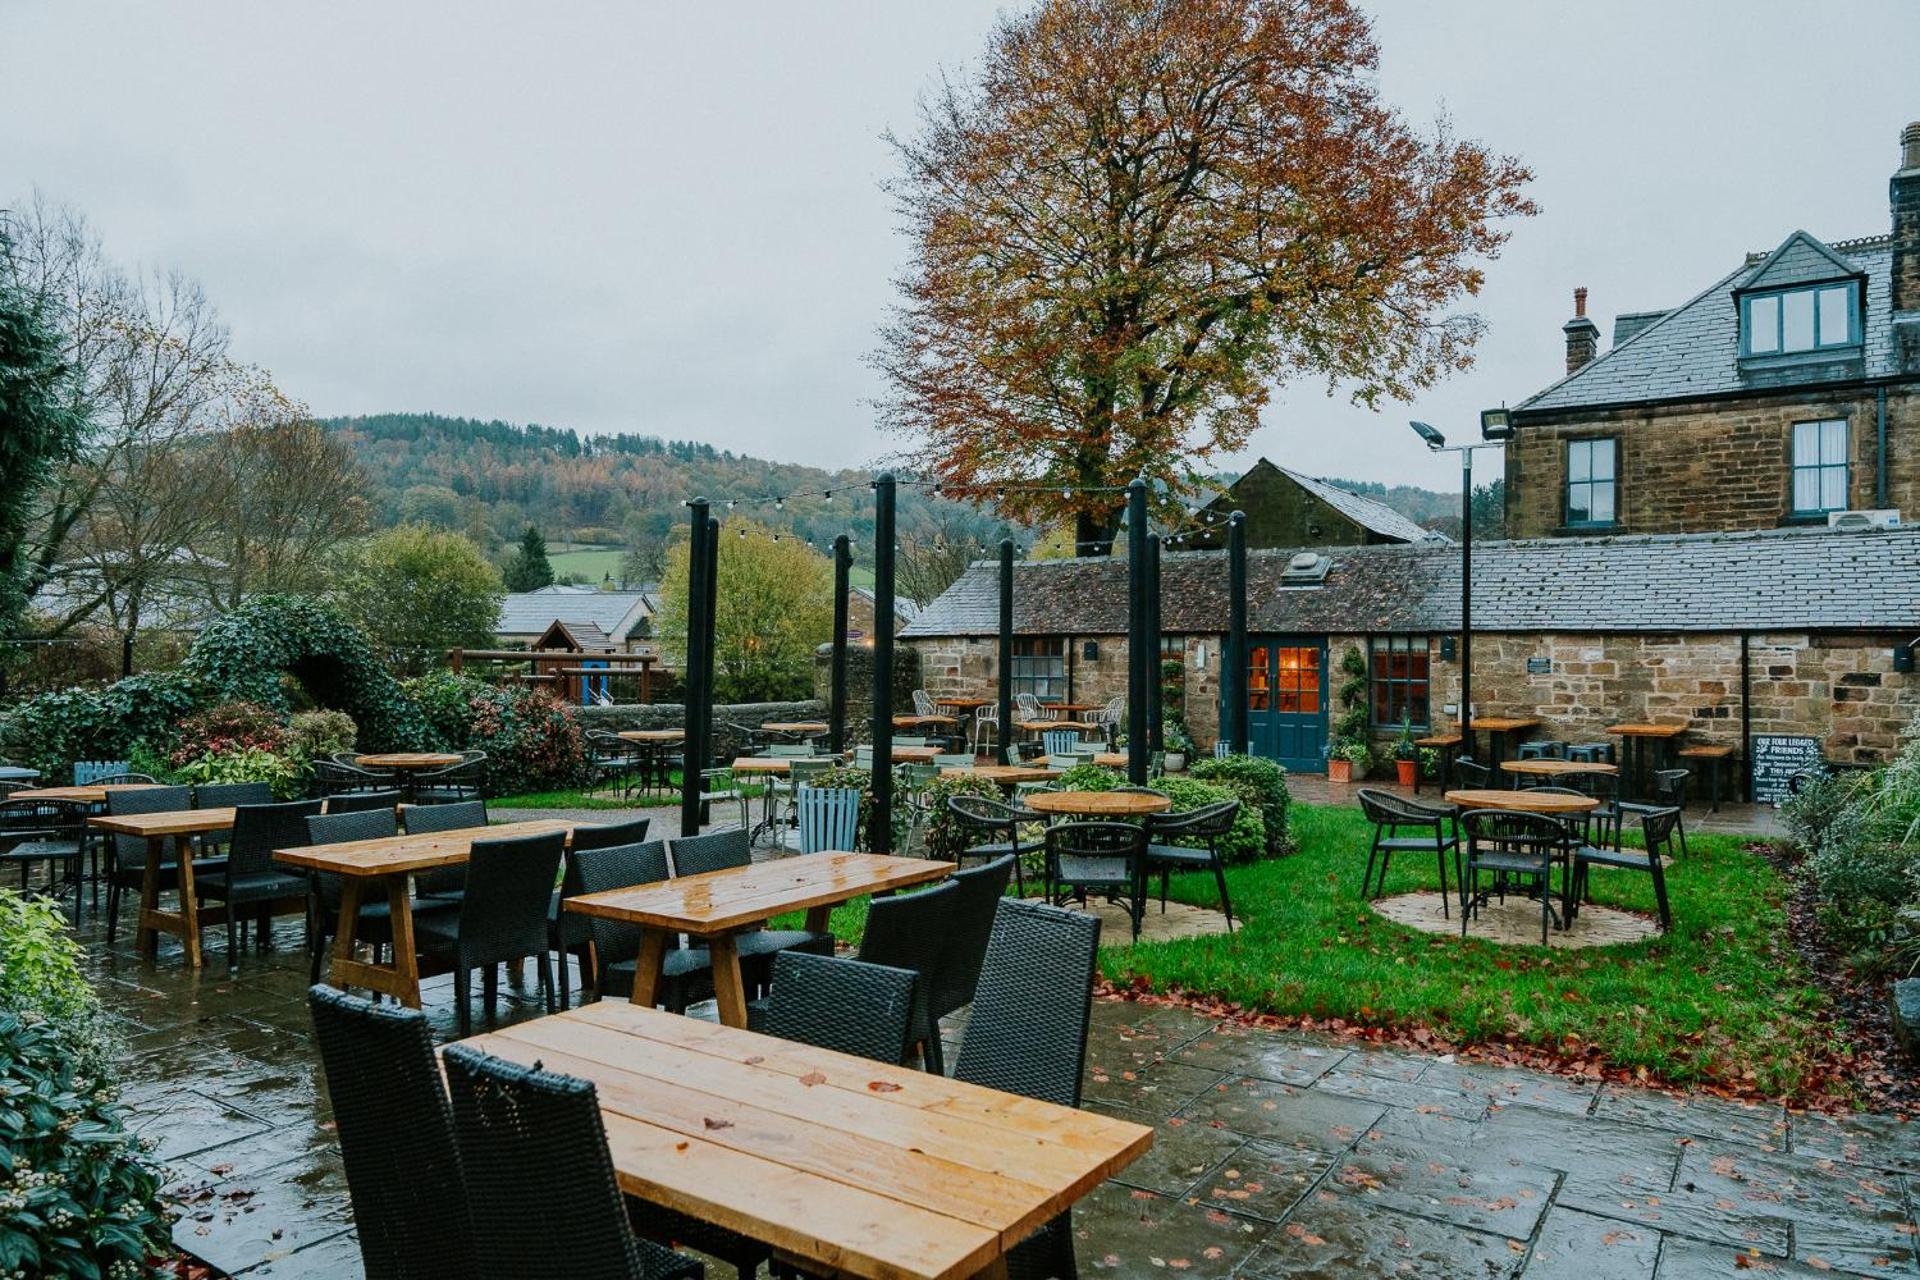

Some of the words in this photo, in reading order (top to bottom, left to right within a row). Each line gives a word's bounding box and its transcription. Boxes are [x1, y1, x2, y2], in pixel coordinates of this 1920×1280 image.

[1757, 738, 1770, 746] OUR
[1772, 738, 1788, 746] FOUR
[1789, 738, 1814, 746] LEGGED
[1771, 746, 1804, 755] FRIENDS
